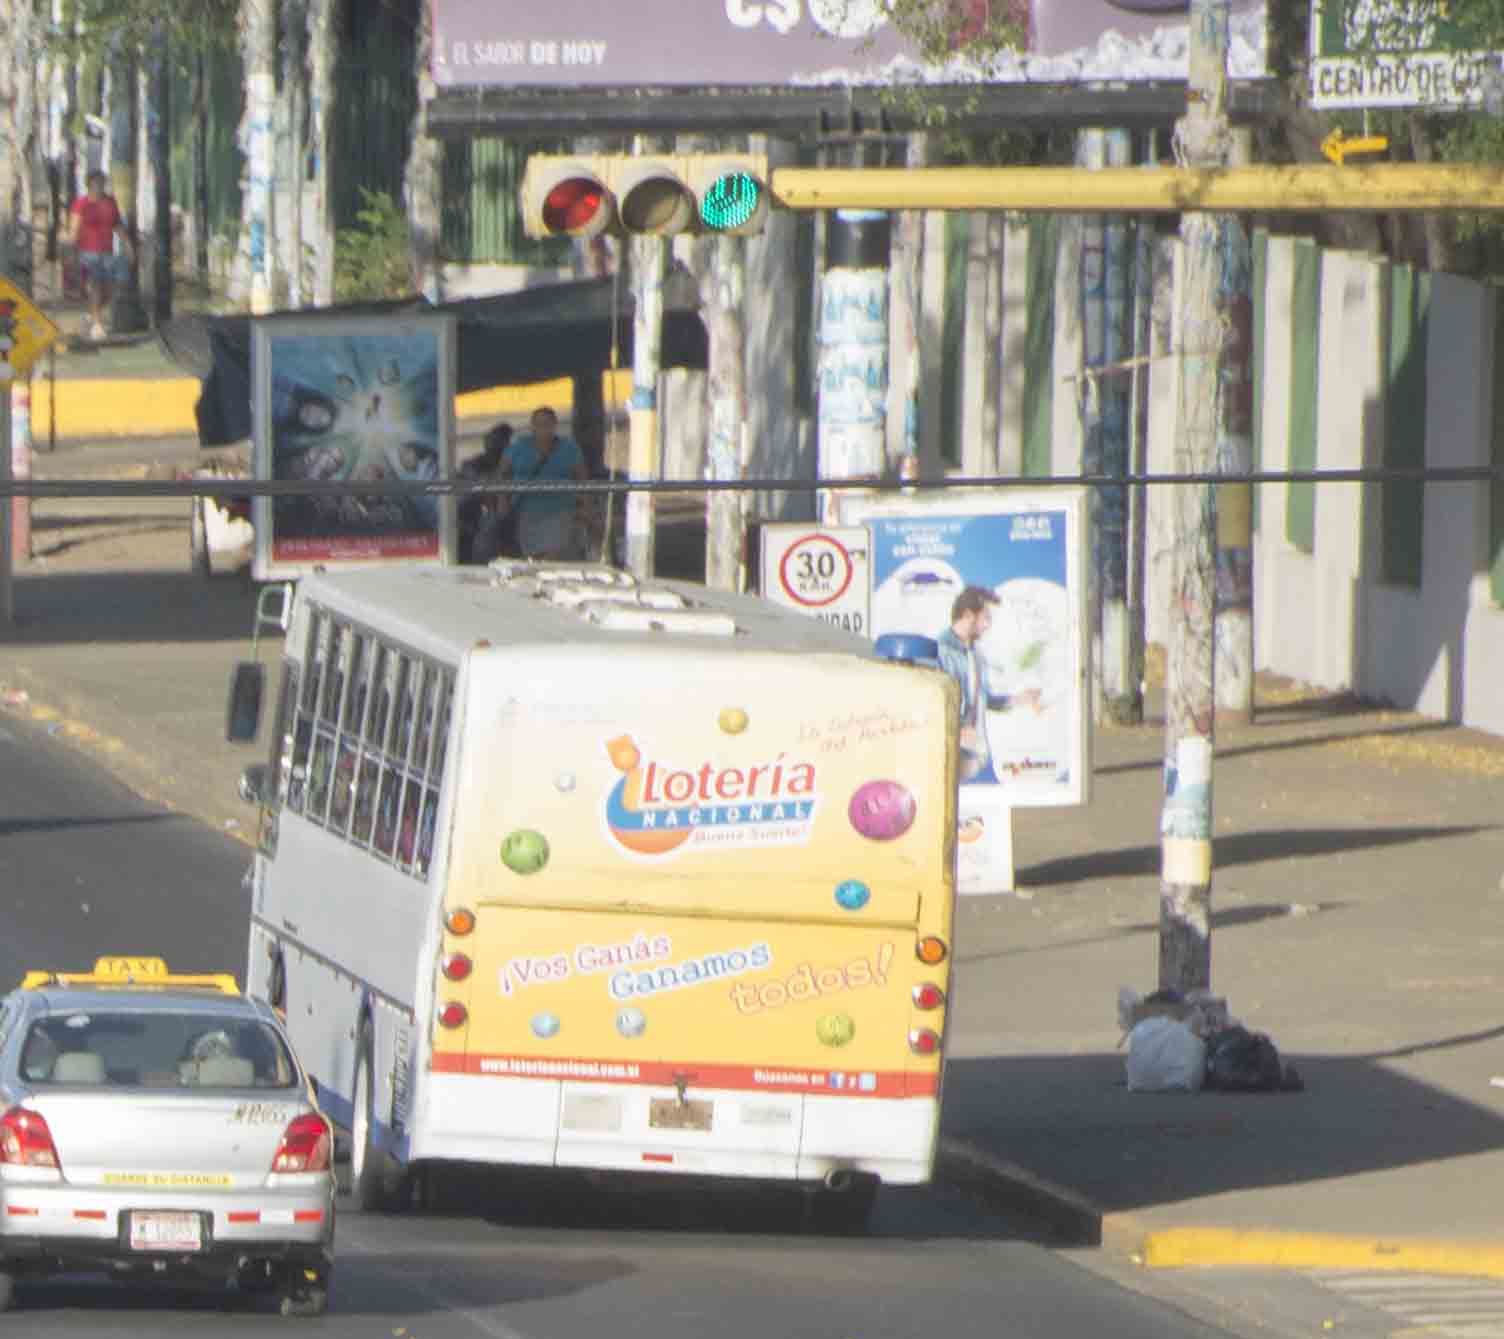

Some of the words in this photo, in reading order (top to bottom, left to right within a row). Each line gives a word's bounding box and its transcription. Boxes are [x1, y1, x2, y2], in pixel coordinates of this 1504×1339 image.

[529, 42, 557, 64] DE
[562, 43, 607, 65] HOY
[1320, 64, 1408, 96] CENTRO
[1420, 63, 1449, 98] DE
[796, 550, 835, 577] 30
[643, 751, 818, 803] Lotería
[643, 800, 814, 827] NACIONAL
[105, 958, 164, 977] TAXI
[610, 942, 771, 1000] Ganamos
[731, 943, 896, 1014] todos!
